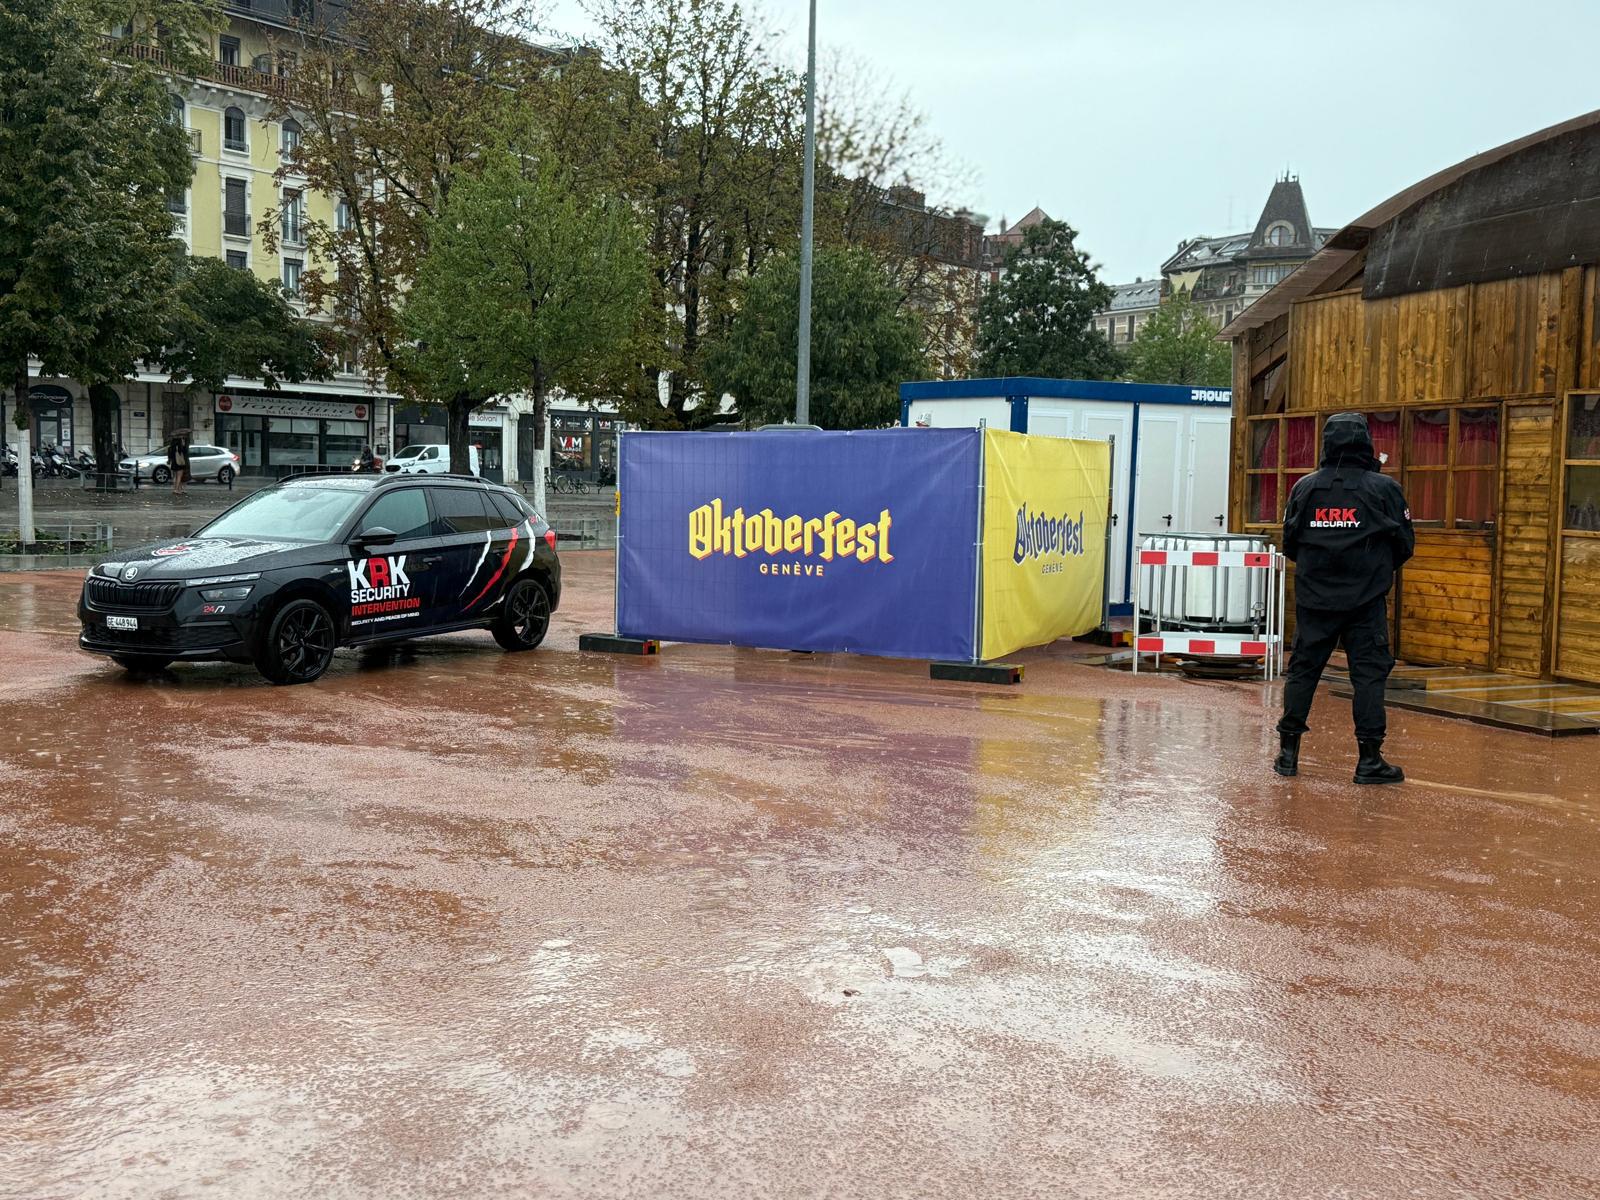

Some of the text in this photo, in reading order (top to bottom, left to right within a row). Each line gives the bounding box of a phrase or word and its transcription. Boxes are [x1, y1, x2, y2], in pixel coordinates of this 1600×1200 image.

[1310, 520, 1360, 528] SECURITY
[1315, 508, 1357, 521] KRK
[689, 498, 894, 564] Oktoberfest
[1013, 501, 1084, 566] Oktoberfest
[347, 555, 410, 590] KRK
[759, 561, 824, 576] GENÈVE
[351, 583, 410, 604] SECURITY
[203, 605, 226, 615] 24/7
[351, 597, 420, 616] INTERVENTION
